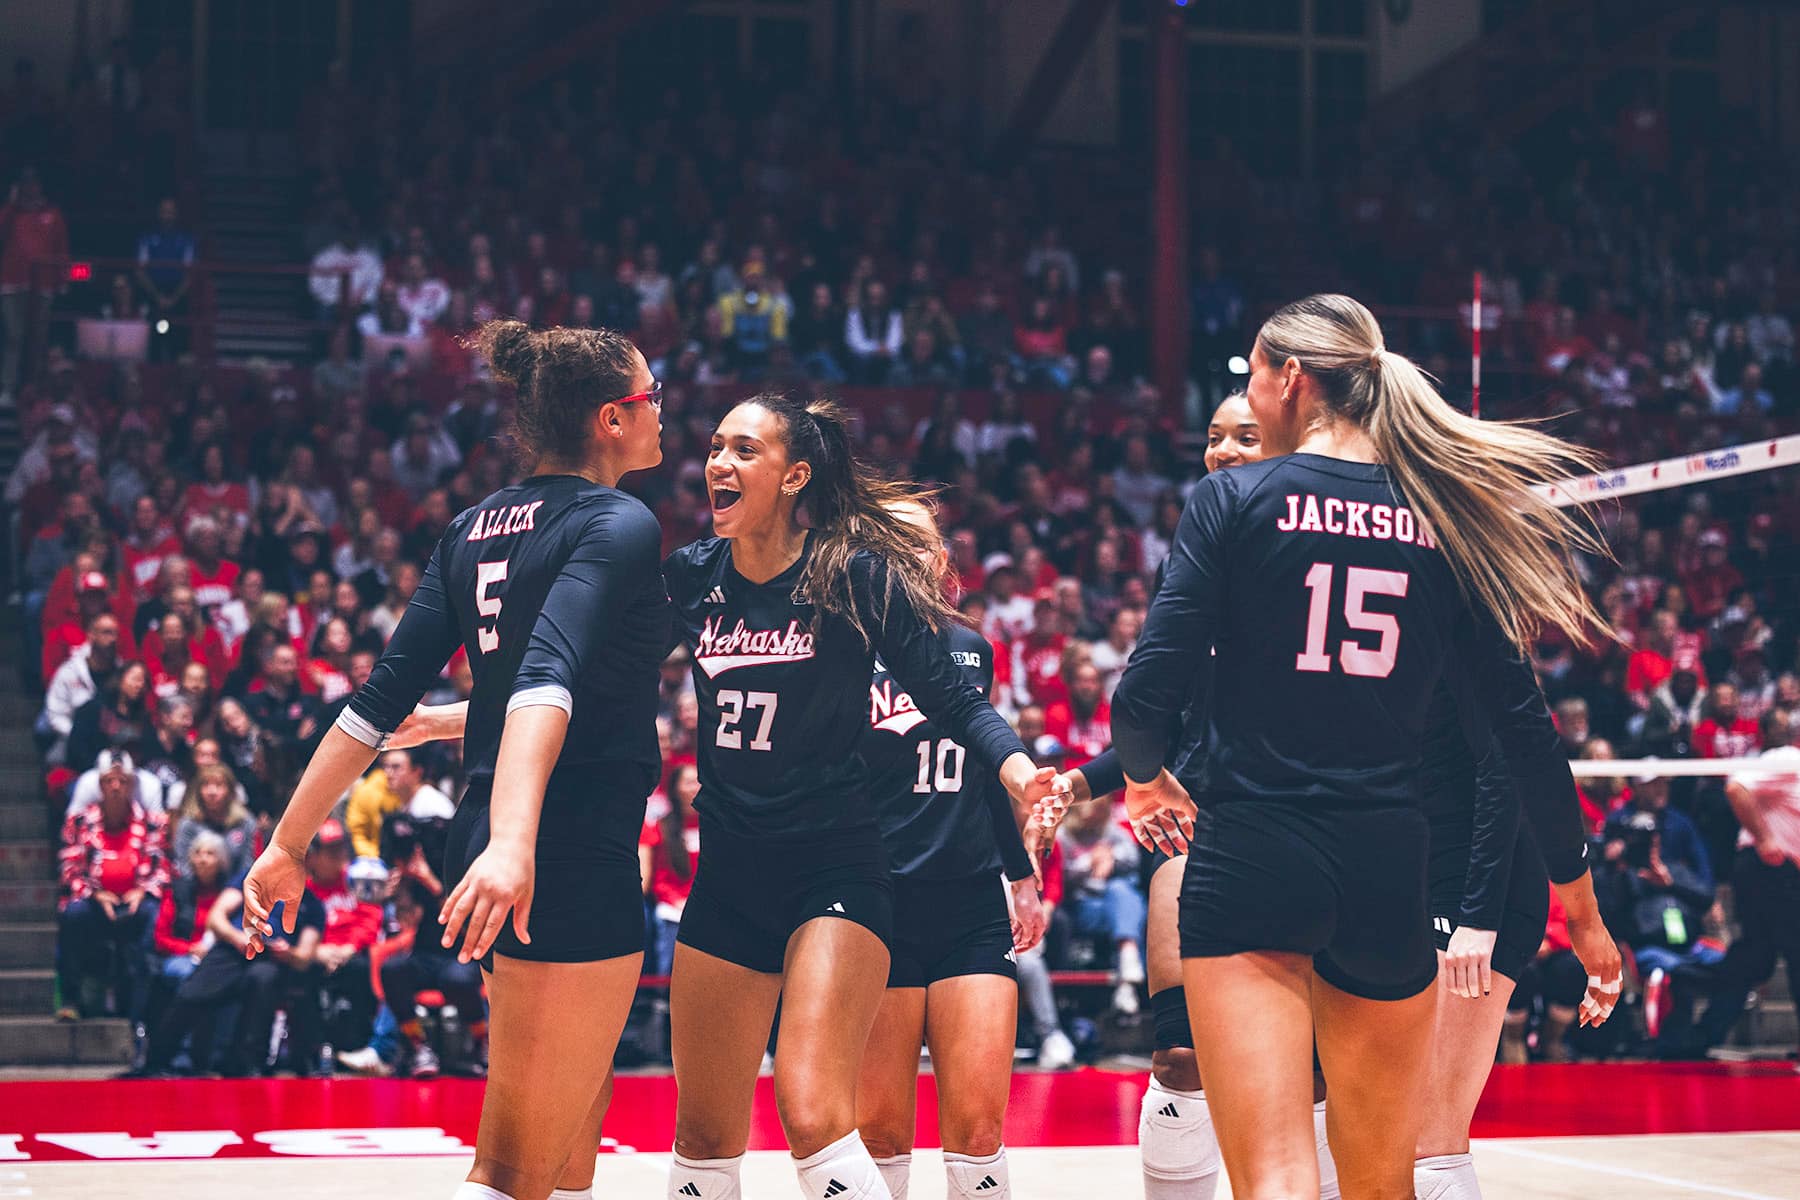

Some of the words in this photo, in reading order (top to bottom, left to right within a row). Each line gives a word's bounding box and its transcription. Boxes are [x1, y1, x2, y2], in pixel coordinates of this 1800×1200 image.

[467, 500, 545, 542] ALLICK
[475, 559, 509, 655] 5
[1296, 562, 1409, 678] 15
[694, 615, 816, 657] Nebraska
[715, 689, 778, 751] 27
[869, 679, 919, 725] Ne
[913, 738, 966, 793] 10
